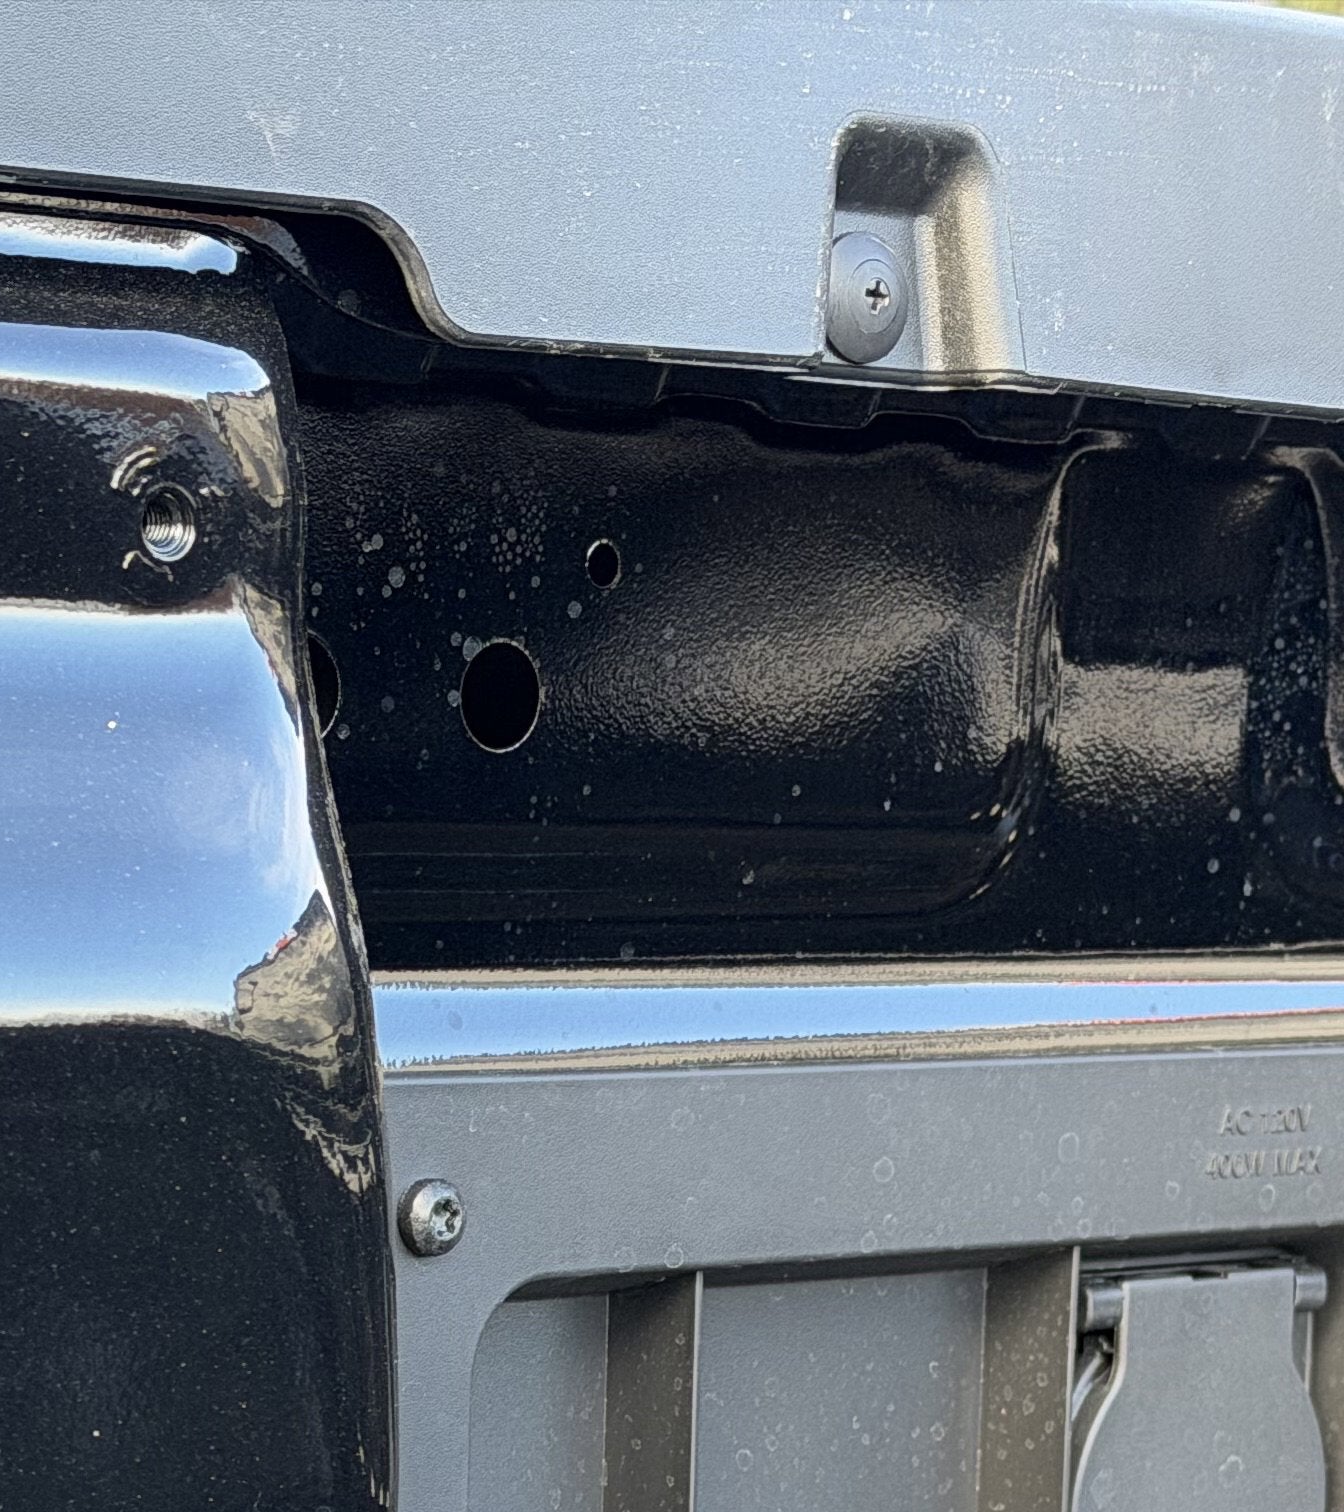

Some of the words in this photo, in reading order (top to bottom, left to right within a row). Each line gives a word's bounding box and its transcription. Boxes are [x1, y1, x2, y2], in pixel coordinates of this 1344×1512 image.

[1218, 1104, 1253, 1137] AC
[1259, 1102, 1312, 1134] 120V
[1272, 1146, 1323, 1177] MAX
